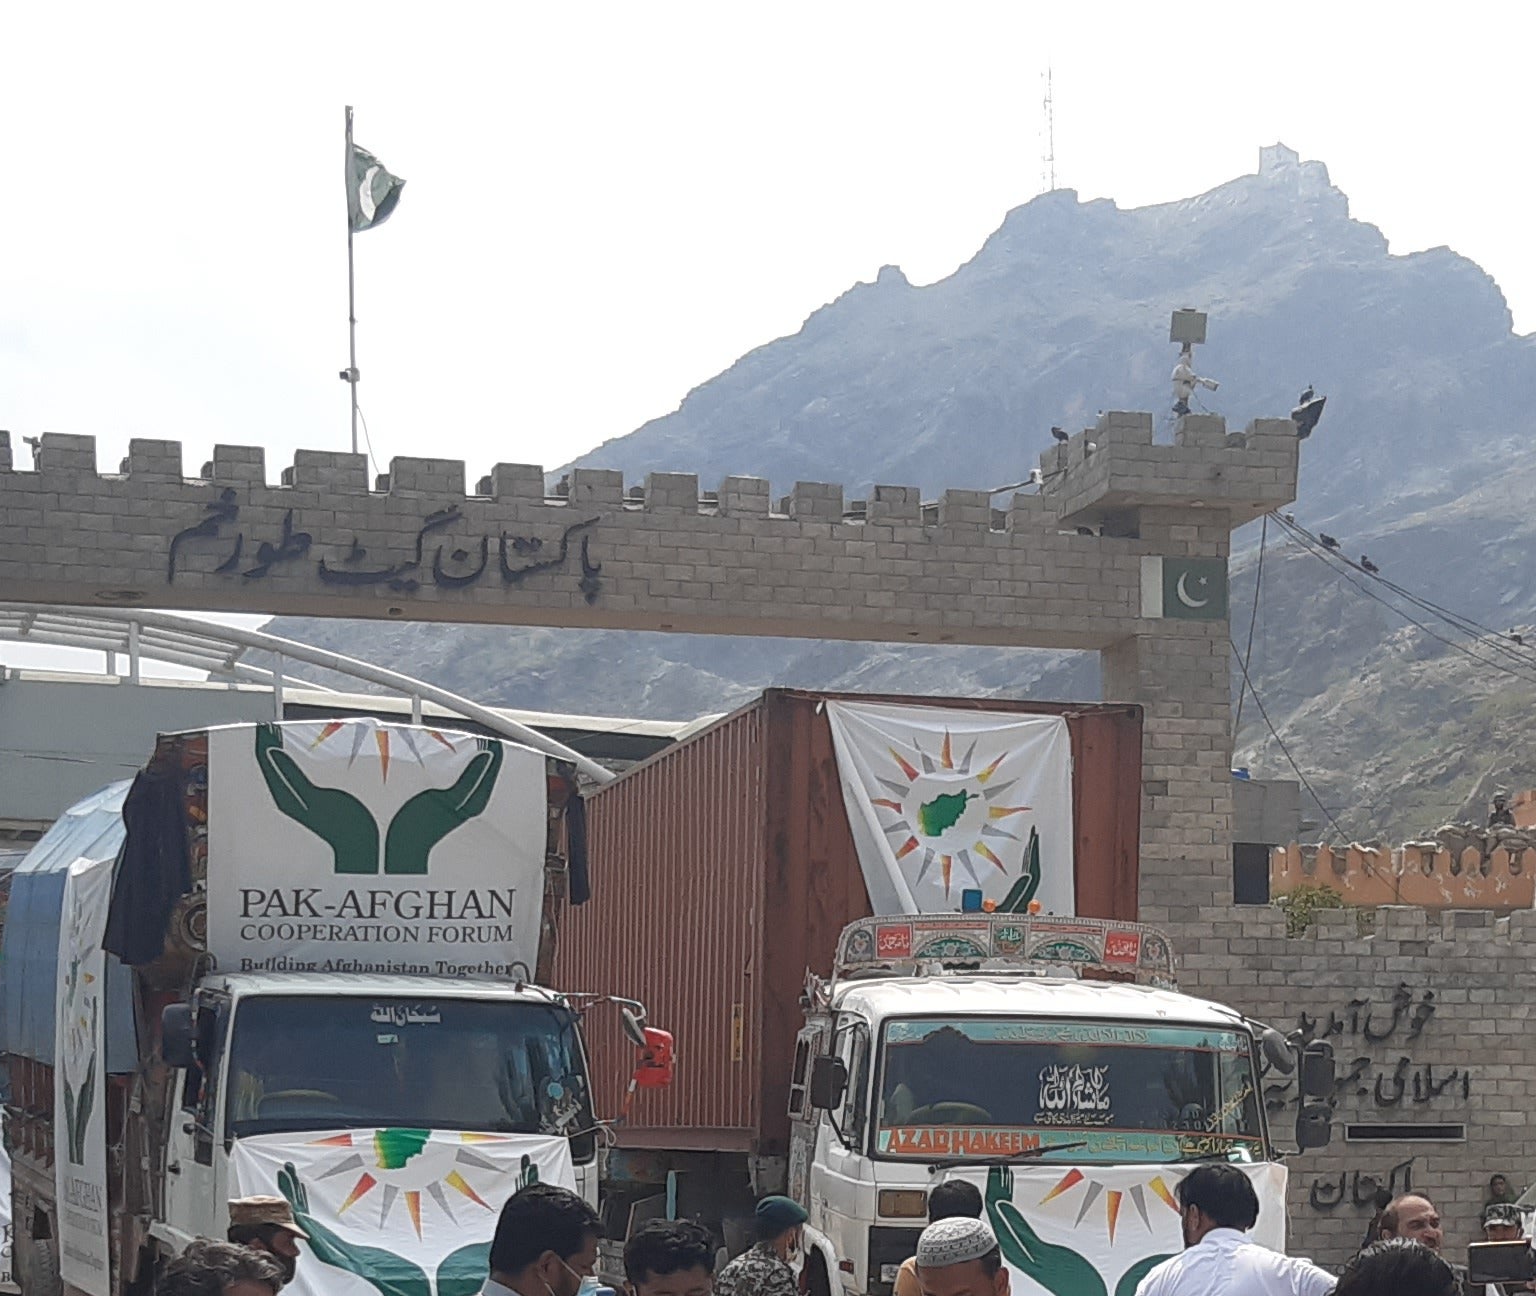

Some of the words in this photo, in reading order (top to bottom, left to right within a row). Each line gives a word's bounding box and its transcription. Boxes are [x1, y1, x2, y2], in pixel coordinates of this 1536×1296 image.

[167, 486, 314, 585] طورخم
[319, 504, 462, 592] گیٹ
[433, 516, 603, 606] پاکستان
[239, 887, 517, 920] PAK-AFGHAN
[240, 923, 420, 943] COOPERATION
[427, 924, 513, 943] FORUM
[240, 957, 316, 972] Building
[322, 959, 430, 974] Afghanistan
[1363, 982, 1436, 1044] خوش
[1374, 1056, 1470, 1107] اسلامی
[951, 1130, 1041, 1156] HAKEEM
